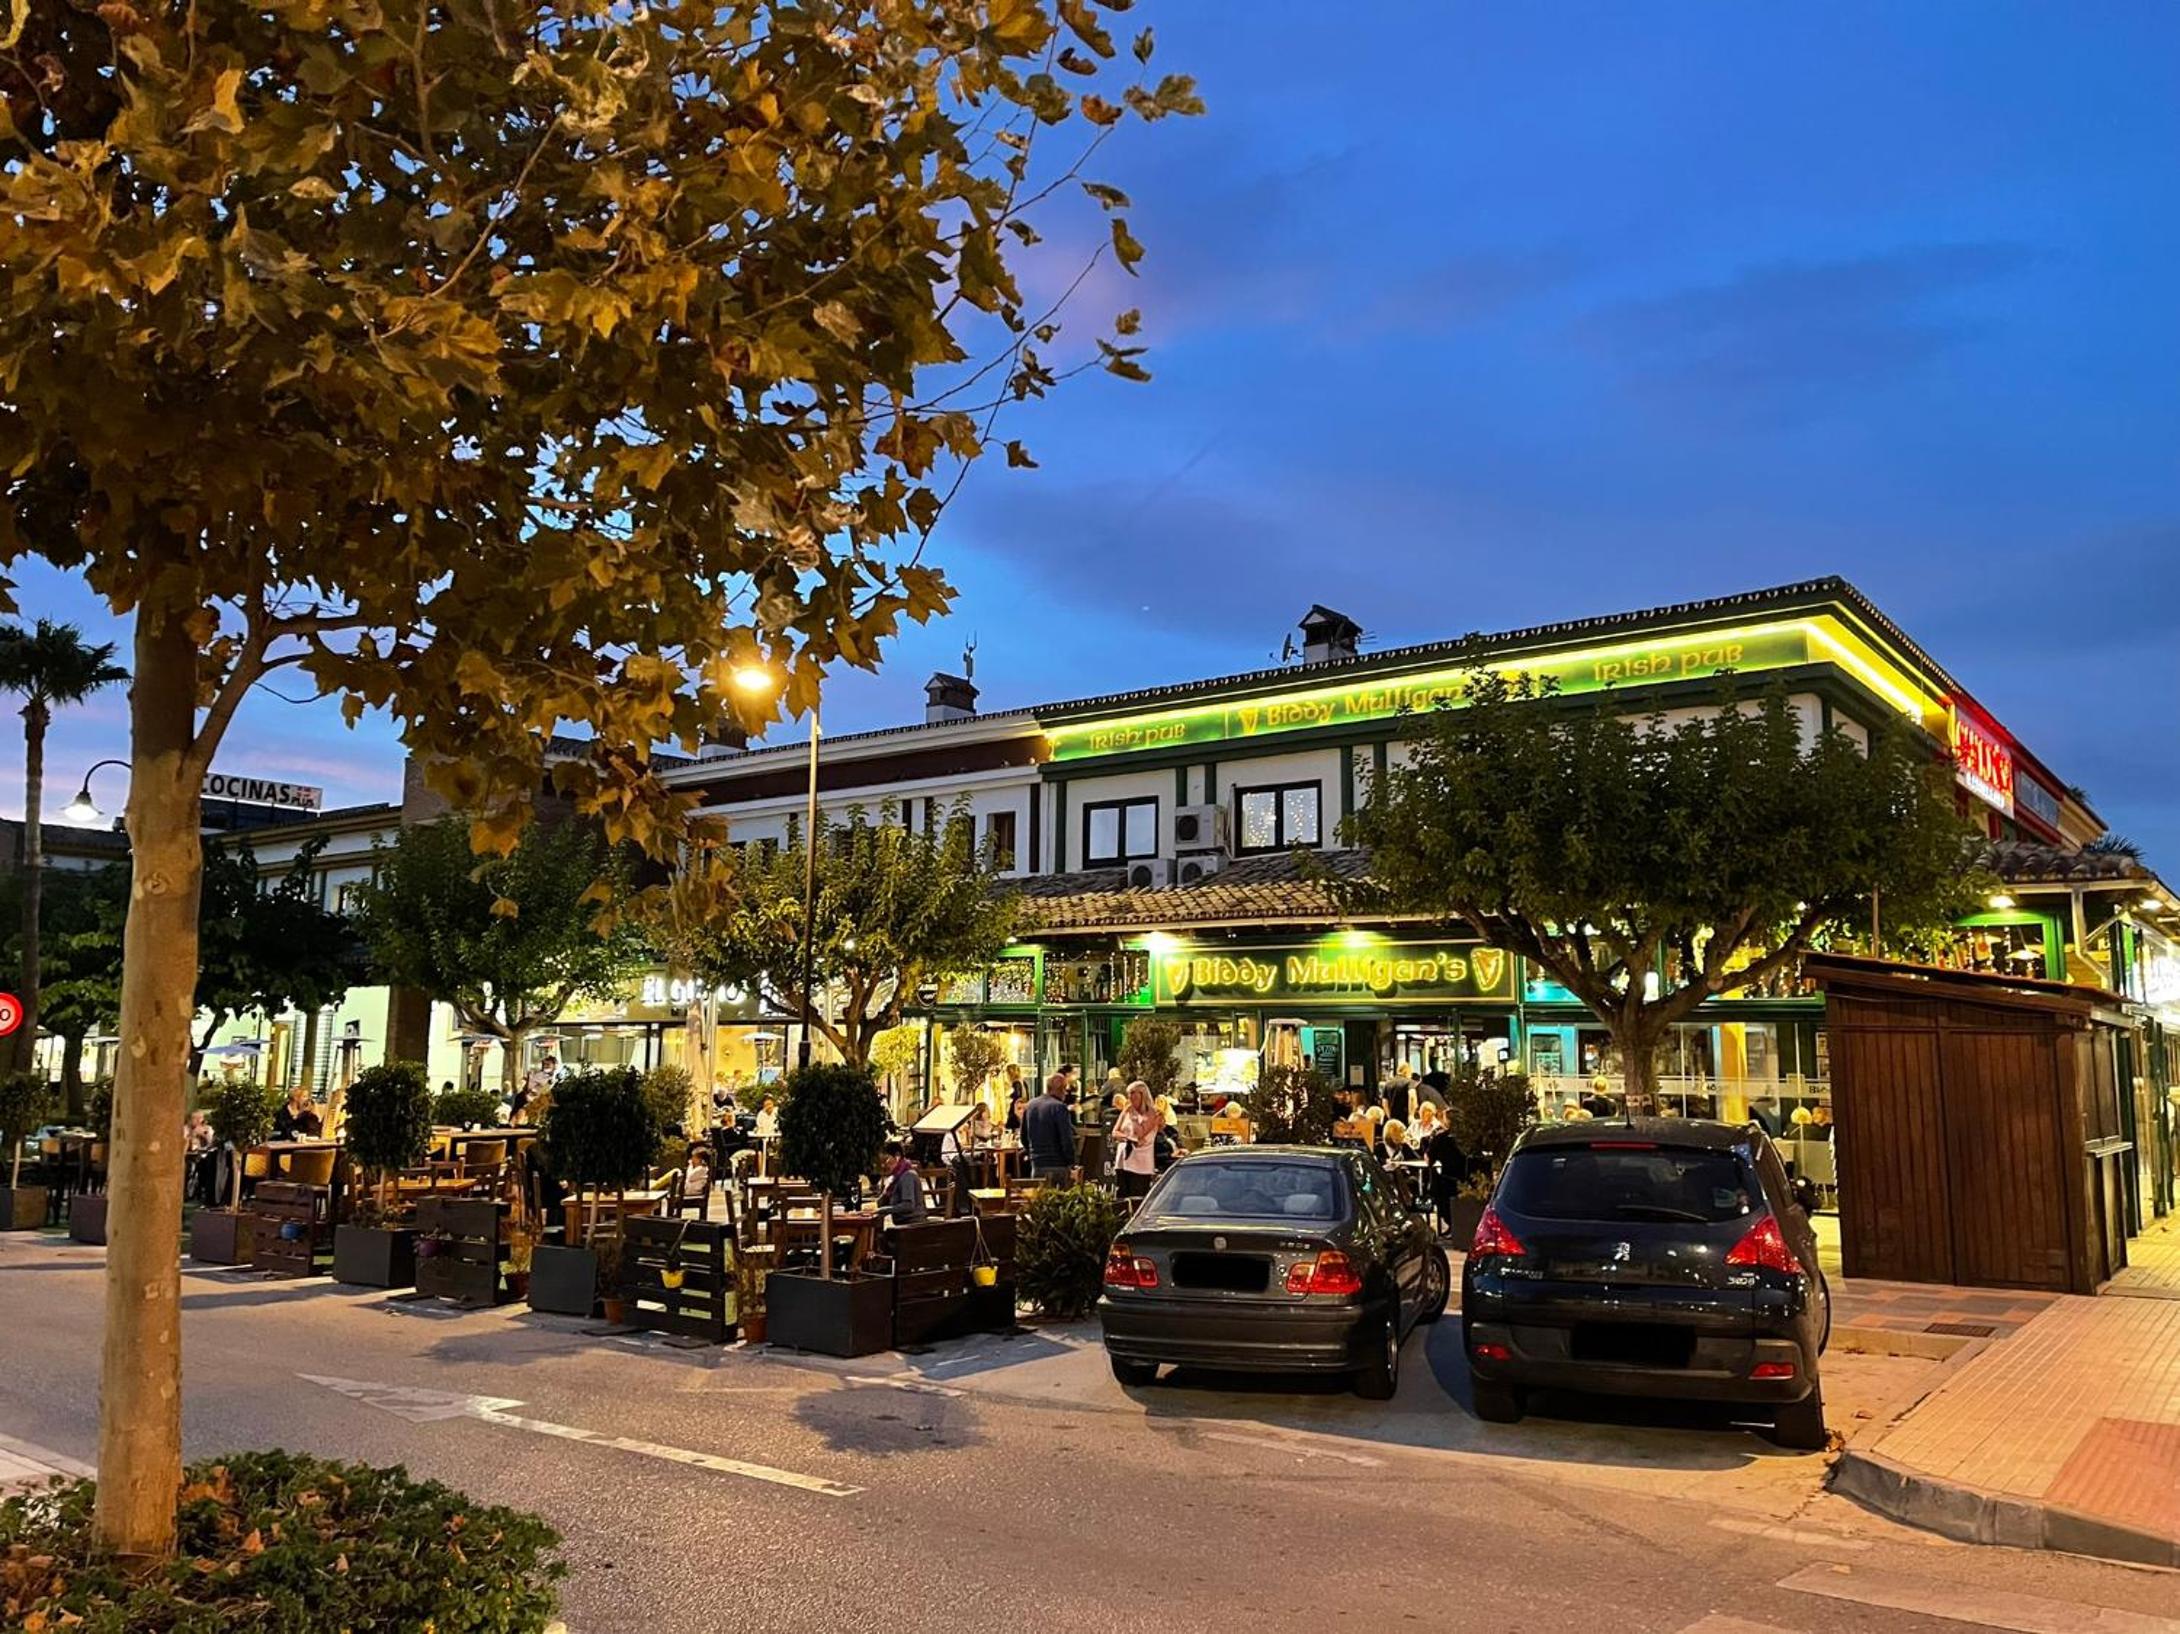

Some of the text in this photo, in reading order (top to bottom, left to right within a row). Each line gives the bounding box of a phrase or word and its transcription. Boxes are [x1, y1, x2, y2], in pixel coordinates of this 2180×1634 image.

[1267, 684, 1464, 725] Biddy Mulligan
[1192, 951, 1468, 992] Biddy Mulligan's
[0, 1008, 11, 1021] 0
